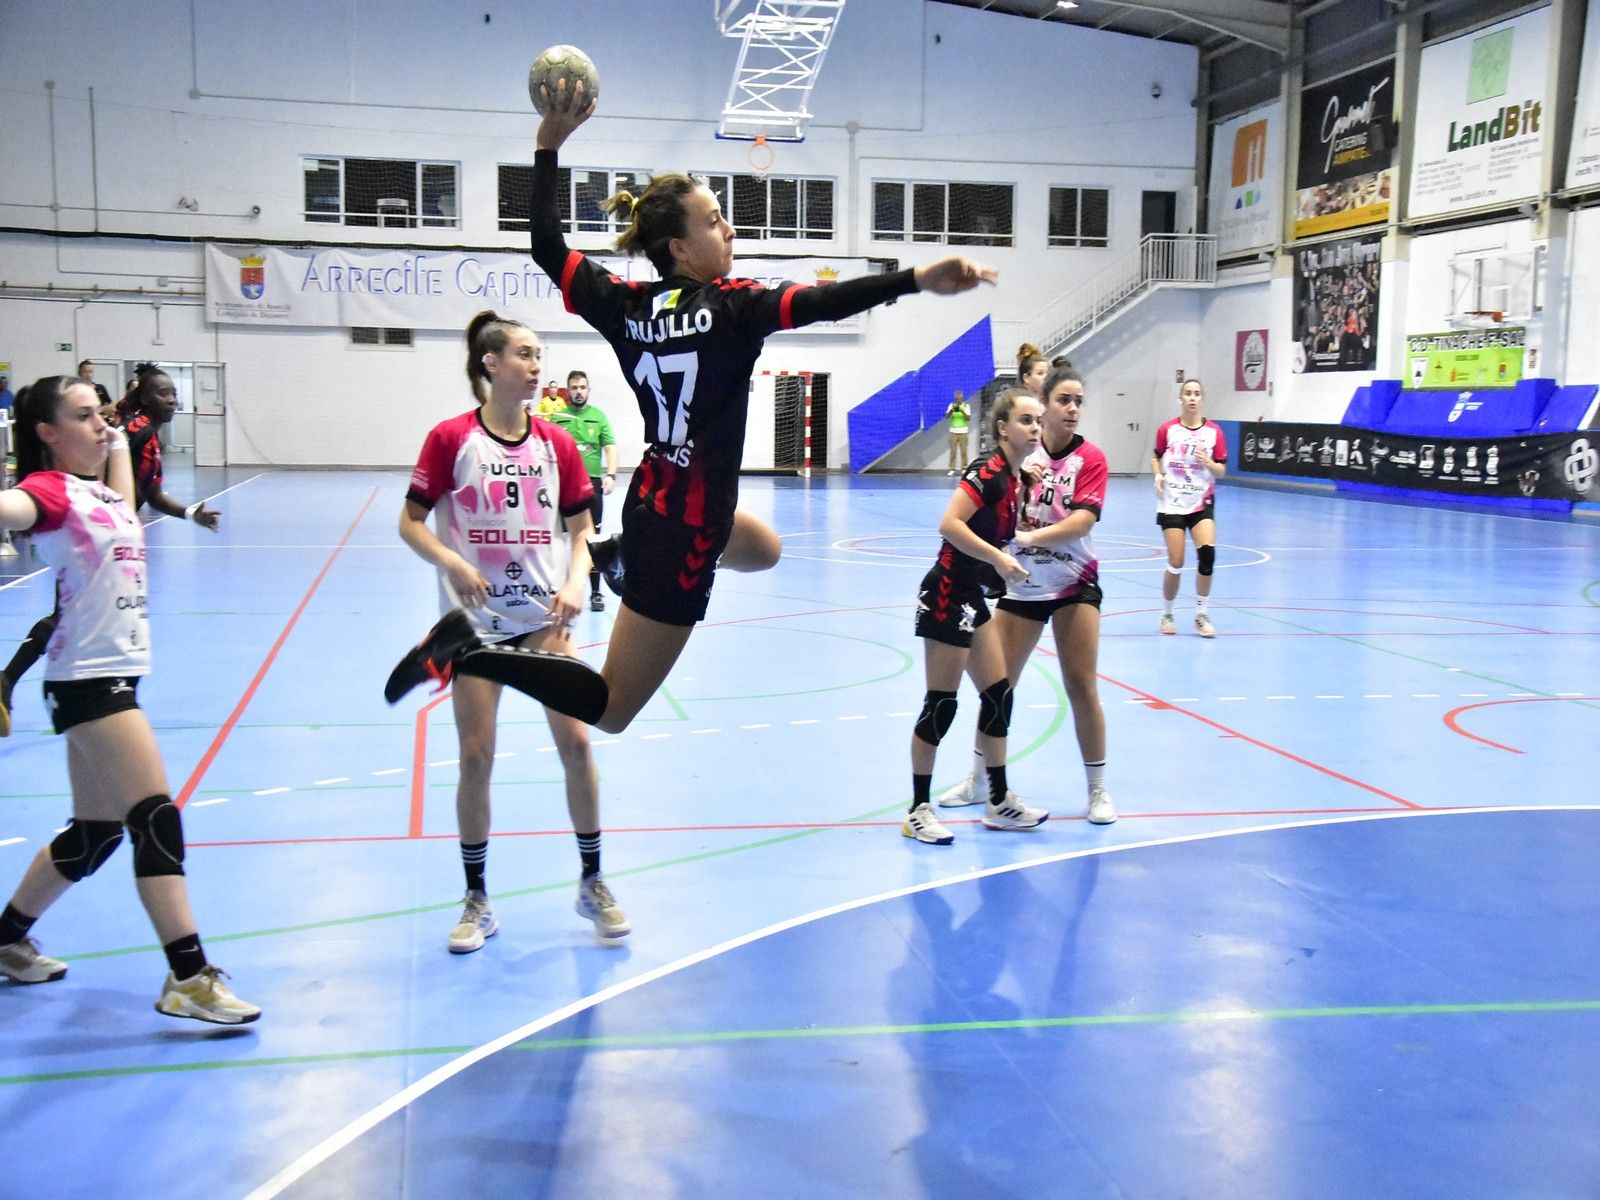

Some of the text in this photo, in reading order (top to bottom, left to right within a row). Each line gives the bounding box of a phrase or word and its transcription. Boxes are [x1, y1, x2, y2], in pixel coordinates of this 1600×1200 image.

[1447, 99, 1542, 153] LandBit
[634, 350, 699, 447] 17
[490, 463, 543, 477] UCLM
[506, 481, 519, 508] 9
[468, 529, 552, 545] SOLISS
